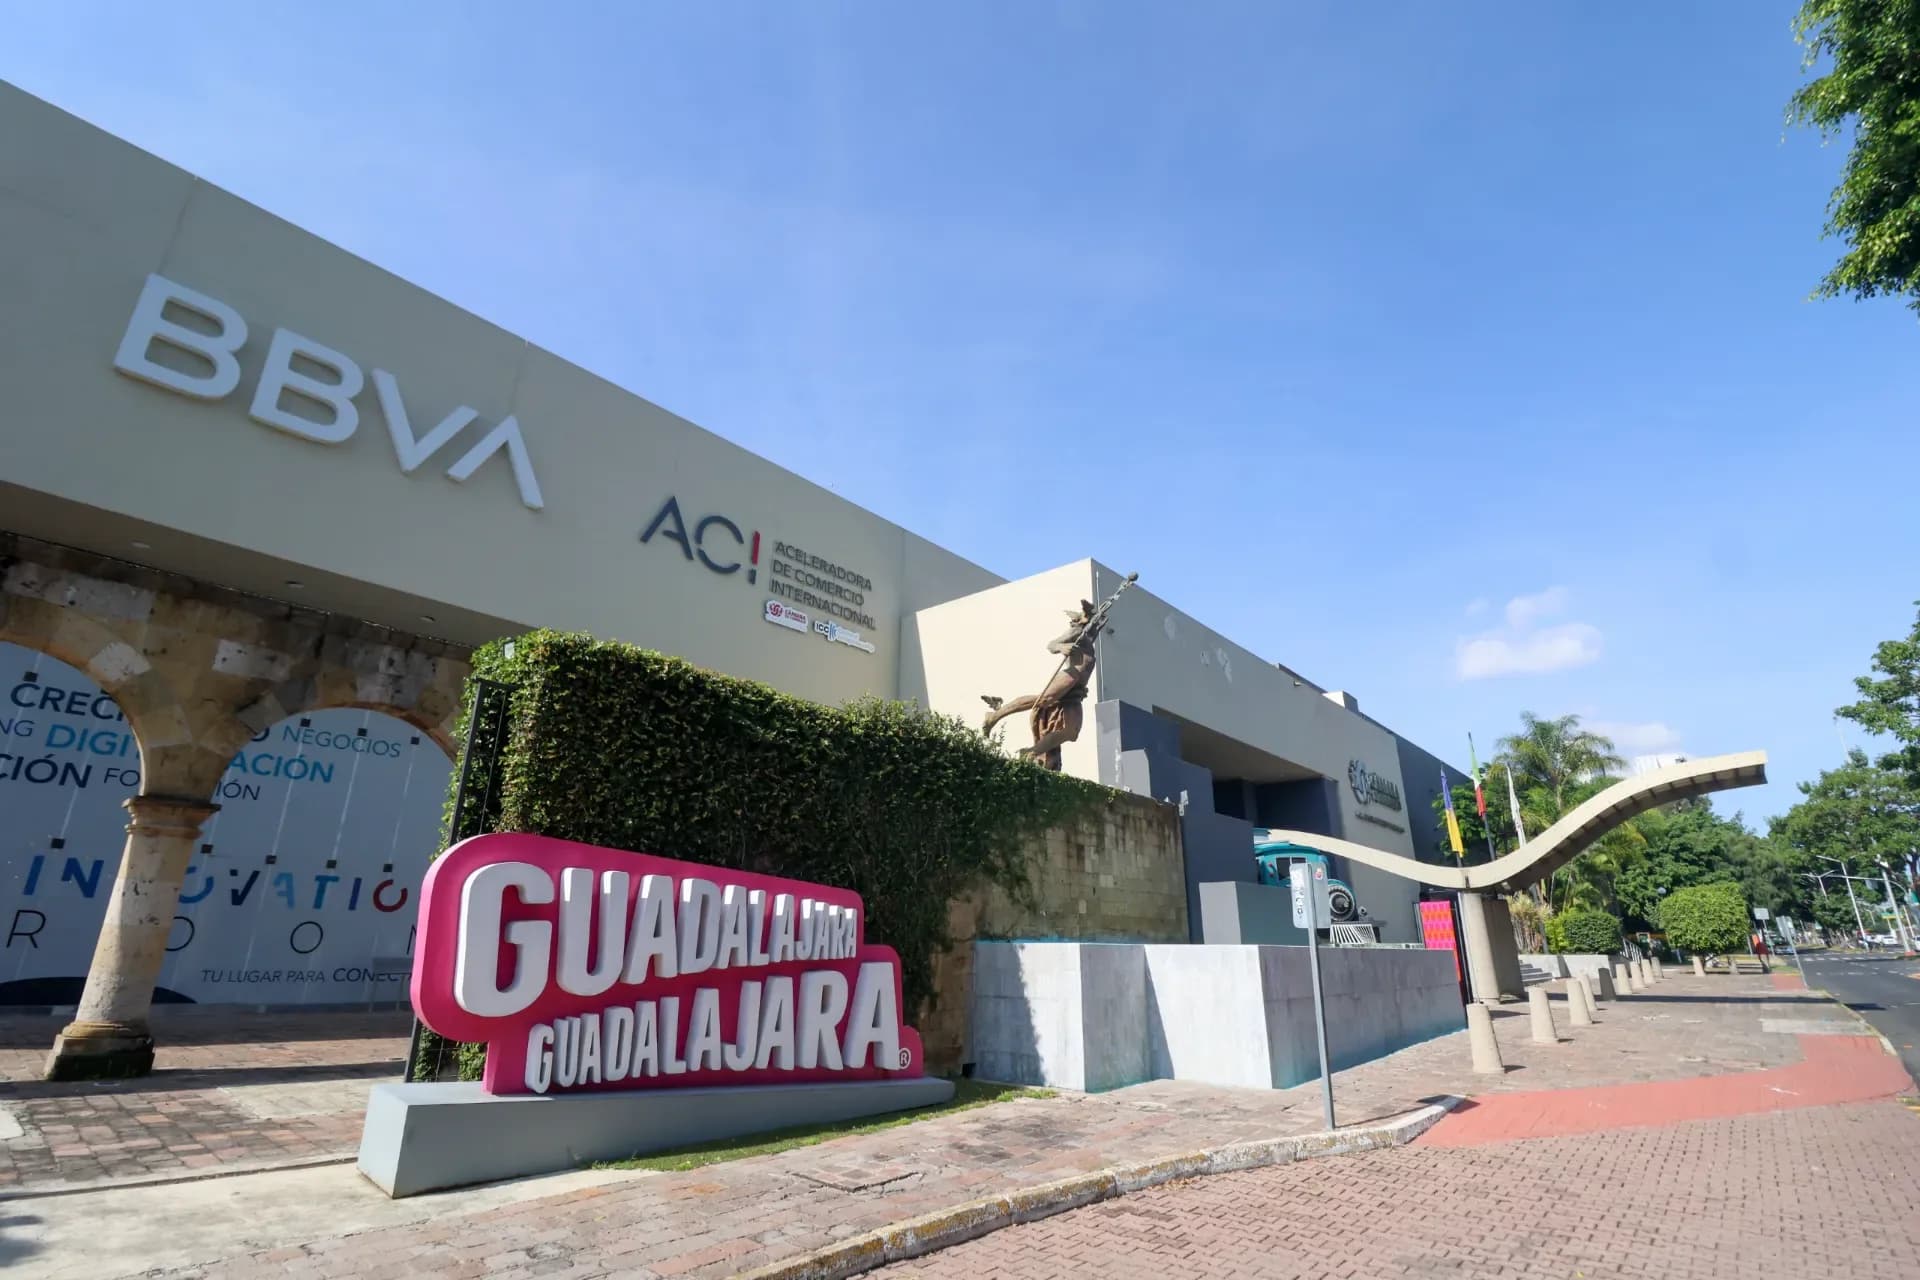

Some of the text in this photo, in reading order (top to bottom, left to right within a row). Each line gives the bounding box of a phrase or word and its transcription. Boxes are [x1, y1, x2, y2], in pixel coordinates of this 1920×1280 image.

[113, 272, 544, 511] BBVA
[772, 559, 865, 606] DE COMERCIO
[774, 540, 873, 592] ACELERADORA
[770, 578, 876, 631] INTERNACIONAL
[816, 622, 829, 634] ICC
[282, 725, 402, 758] NEGOCIOS
[453, 861, 858, 1018] GUADALAJARA
[202, 969, 224, 983] TU
[227, 970, 282, 983] LUGAR
[286, 970, 326, 983] PARA
[524, 961, 900, 1095] GUADALAJARA
